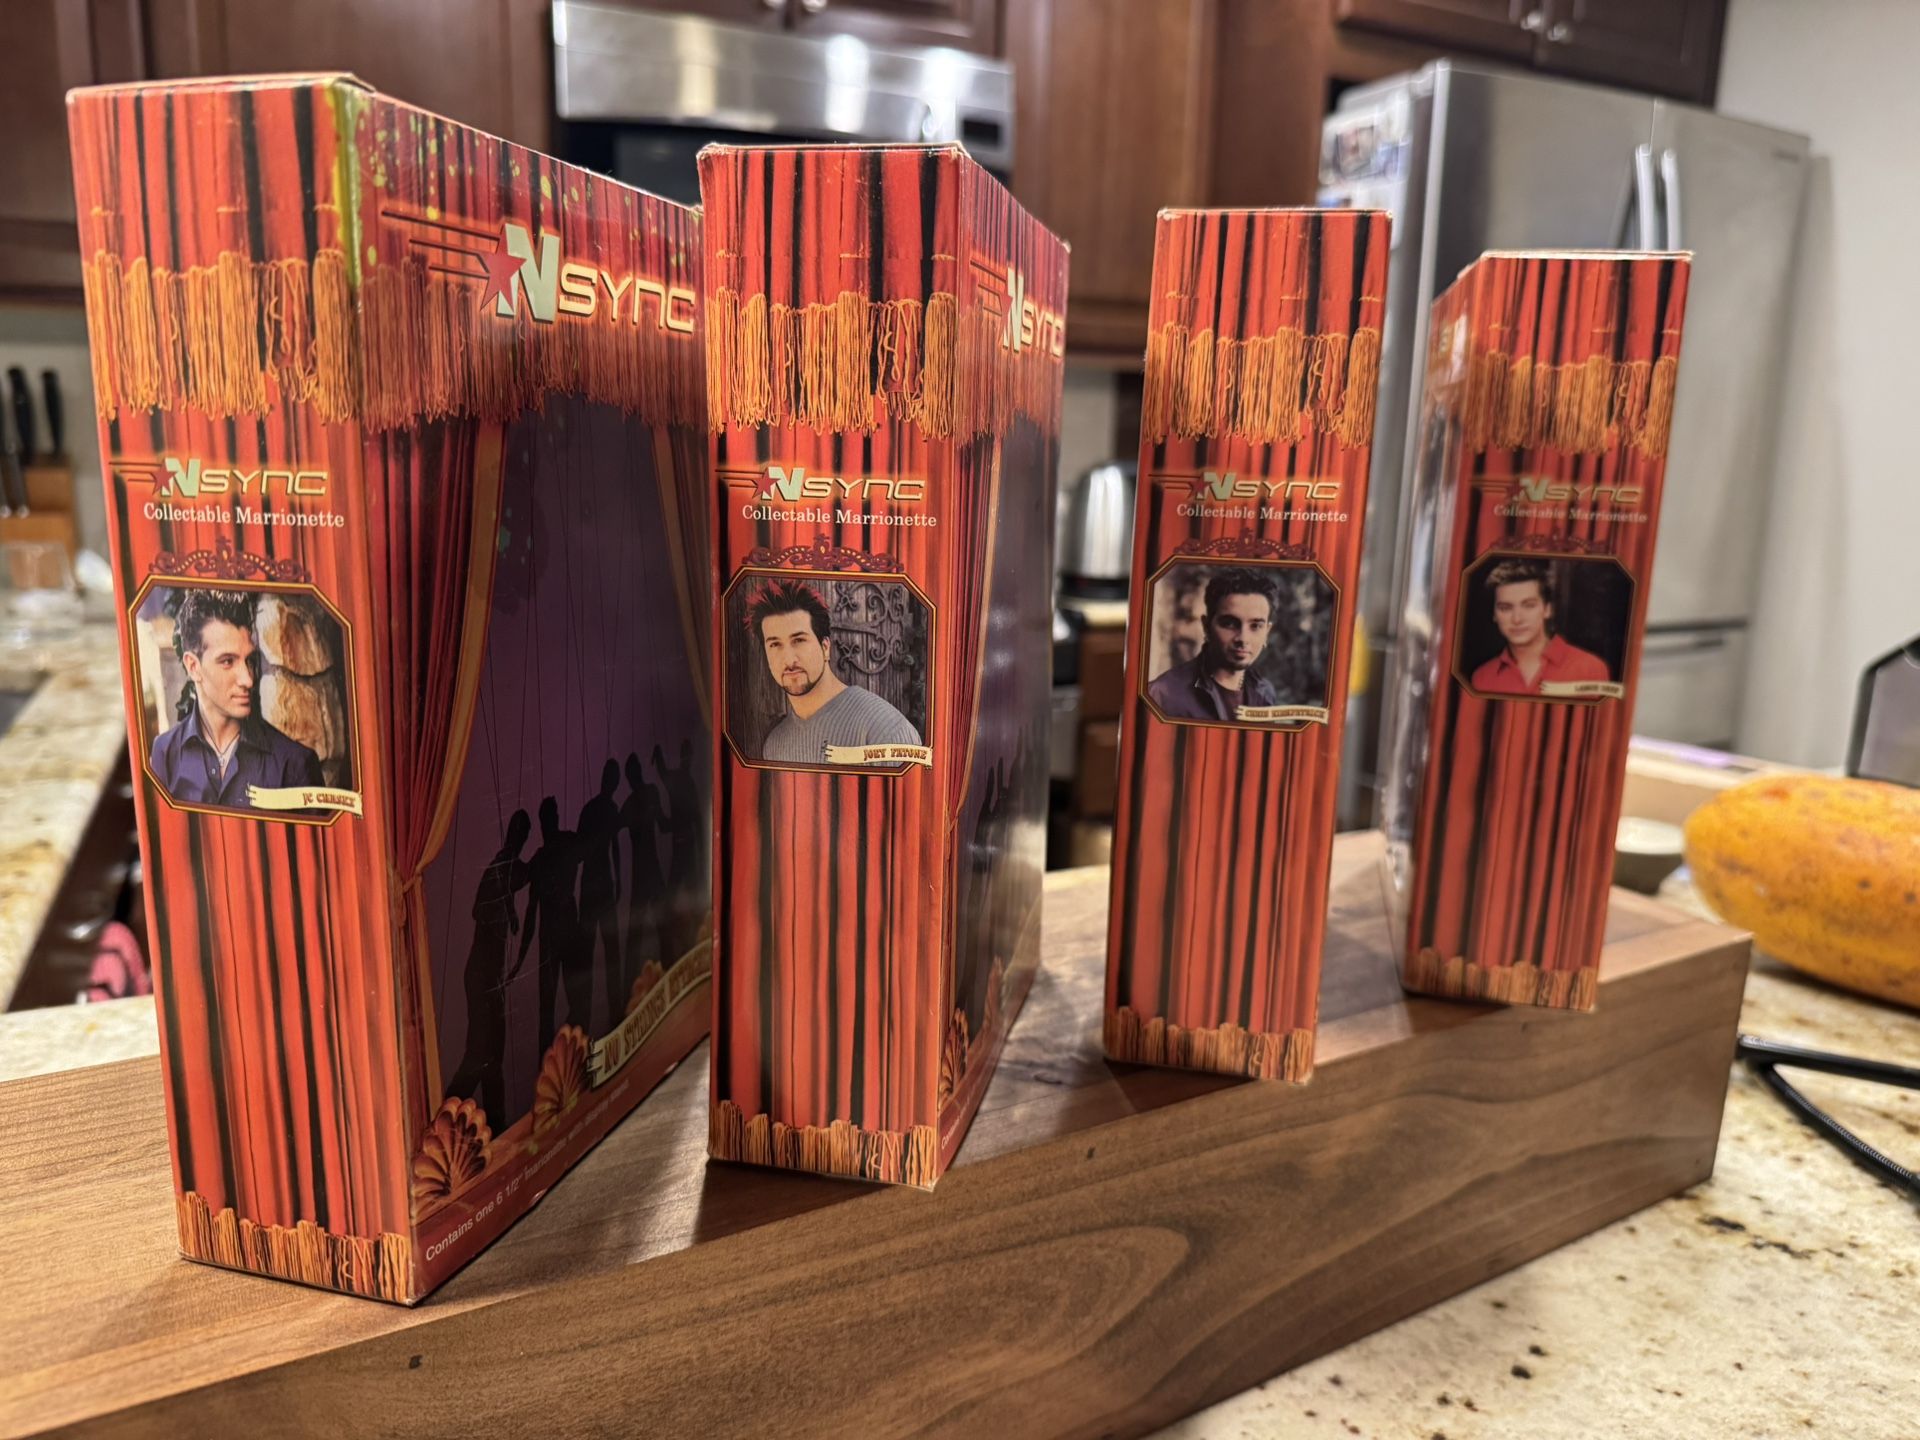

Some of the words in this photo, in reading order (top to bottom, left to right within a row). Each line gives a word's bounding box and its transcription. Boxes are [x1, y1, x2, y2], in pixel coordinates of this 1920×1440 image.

[143, 502, 231, 523] Collectable
[236, 506, 345, 528] Marrionette
[742, 504, 831, 523] Collectable
[835, 509, 937, 527] Marrionette
[1176, 503, 1255, 520] Collectable
[1259, 507, 1348, 522] Marrionette
[1493, 503, 1565, 520] Collectable
[425, 1218, 473, 1261] Contains
[475, 1202, 495, 1223] one
[496, 1191, 503, 1205] 6
